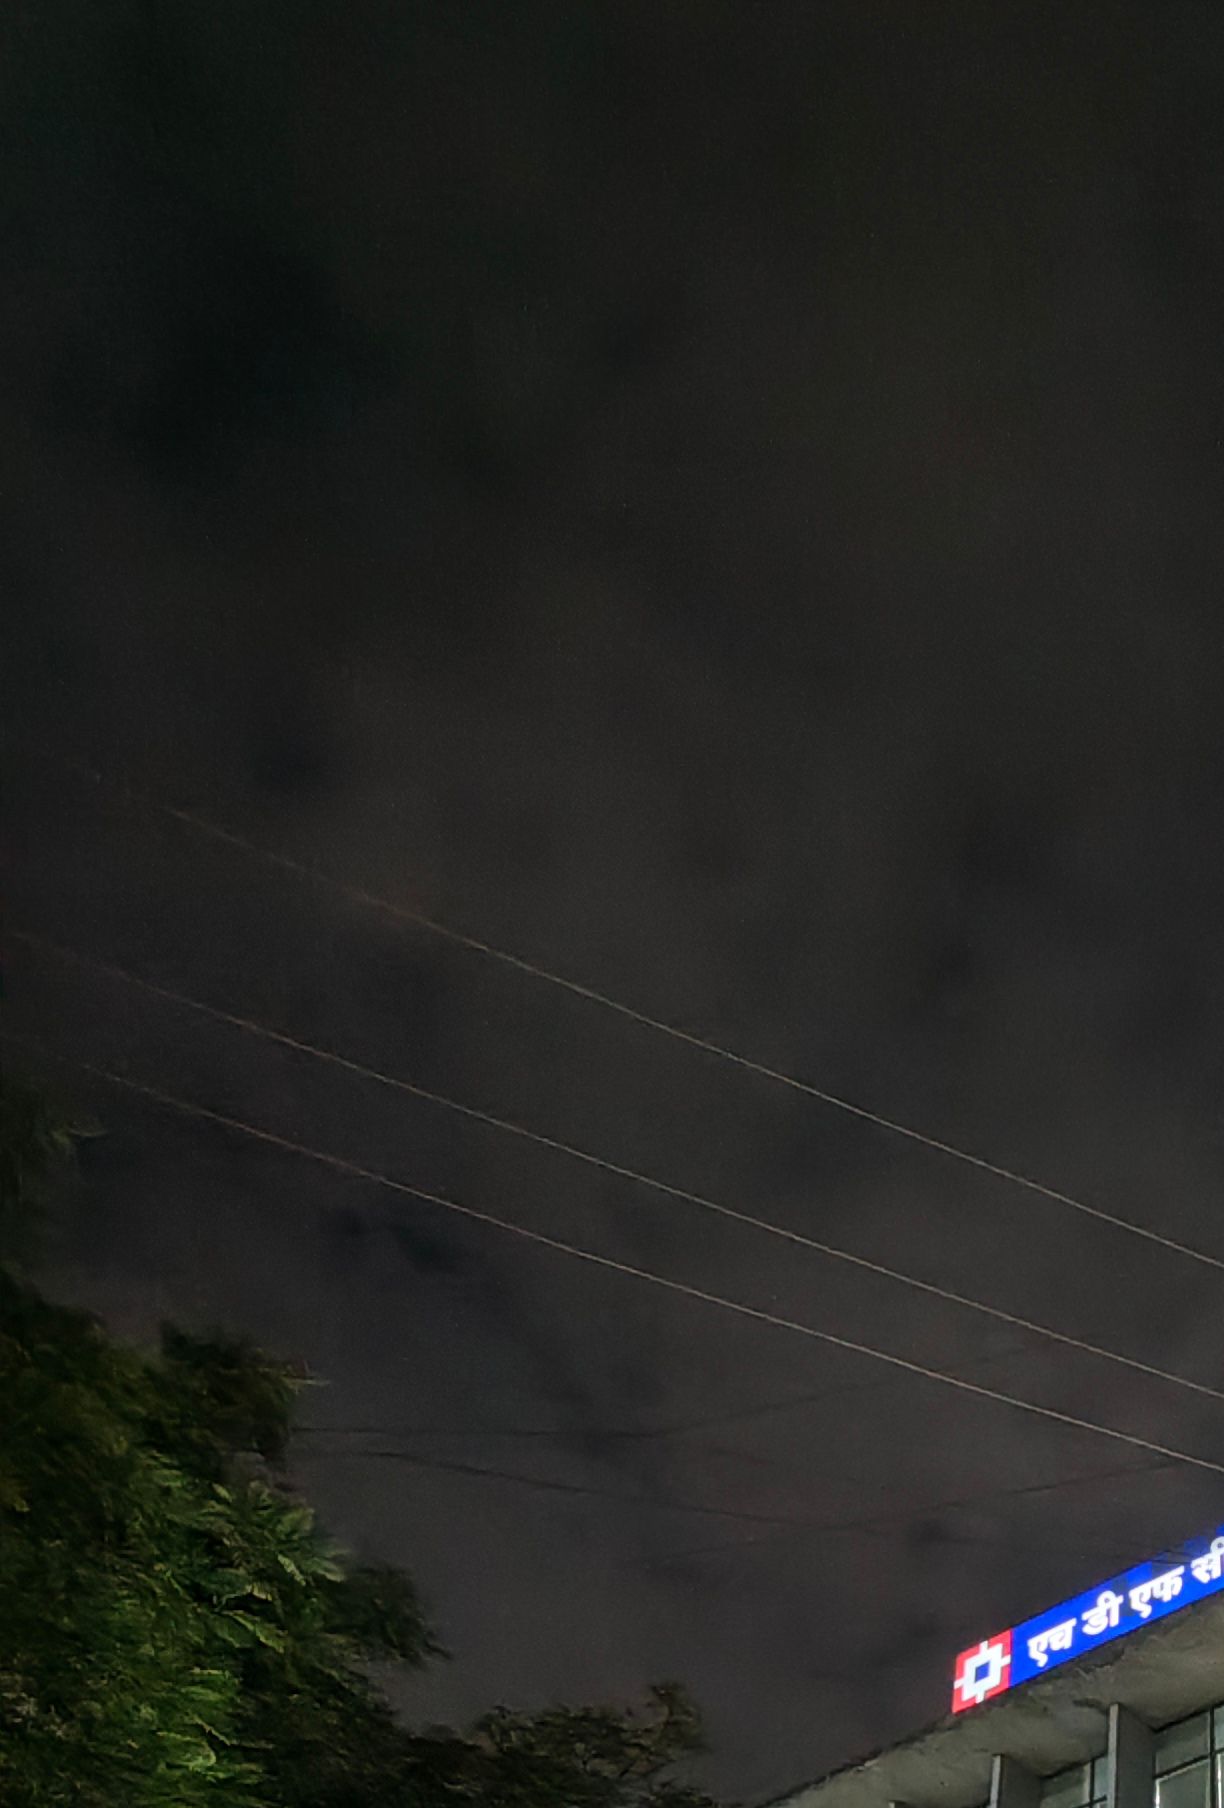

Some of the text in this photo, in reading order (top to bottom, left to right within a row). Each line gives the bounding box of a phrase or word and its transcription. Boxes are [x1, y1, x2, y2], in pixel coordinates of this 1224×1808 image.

[1026, 1617, 1077, 1668] एच
[1081, 1590, 1124, 1636] डी
[1128, 1565, 1185, 1619] एफ
